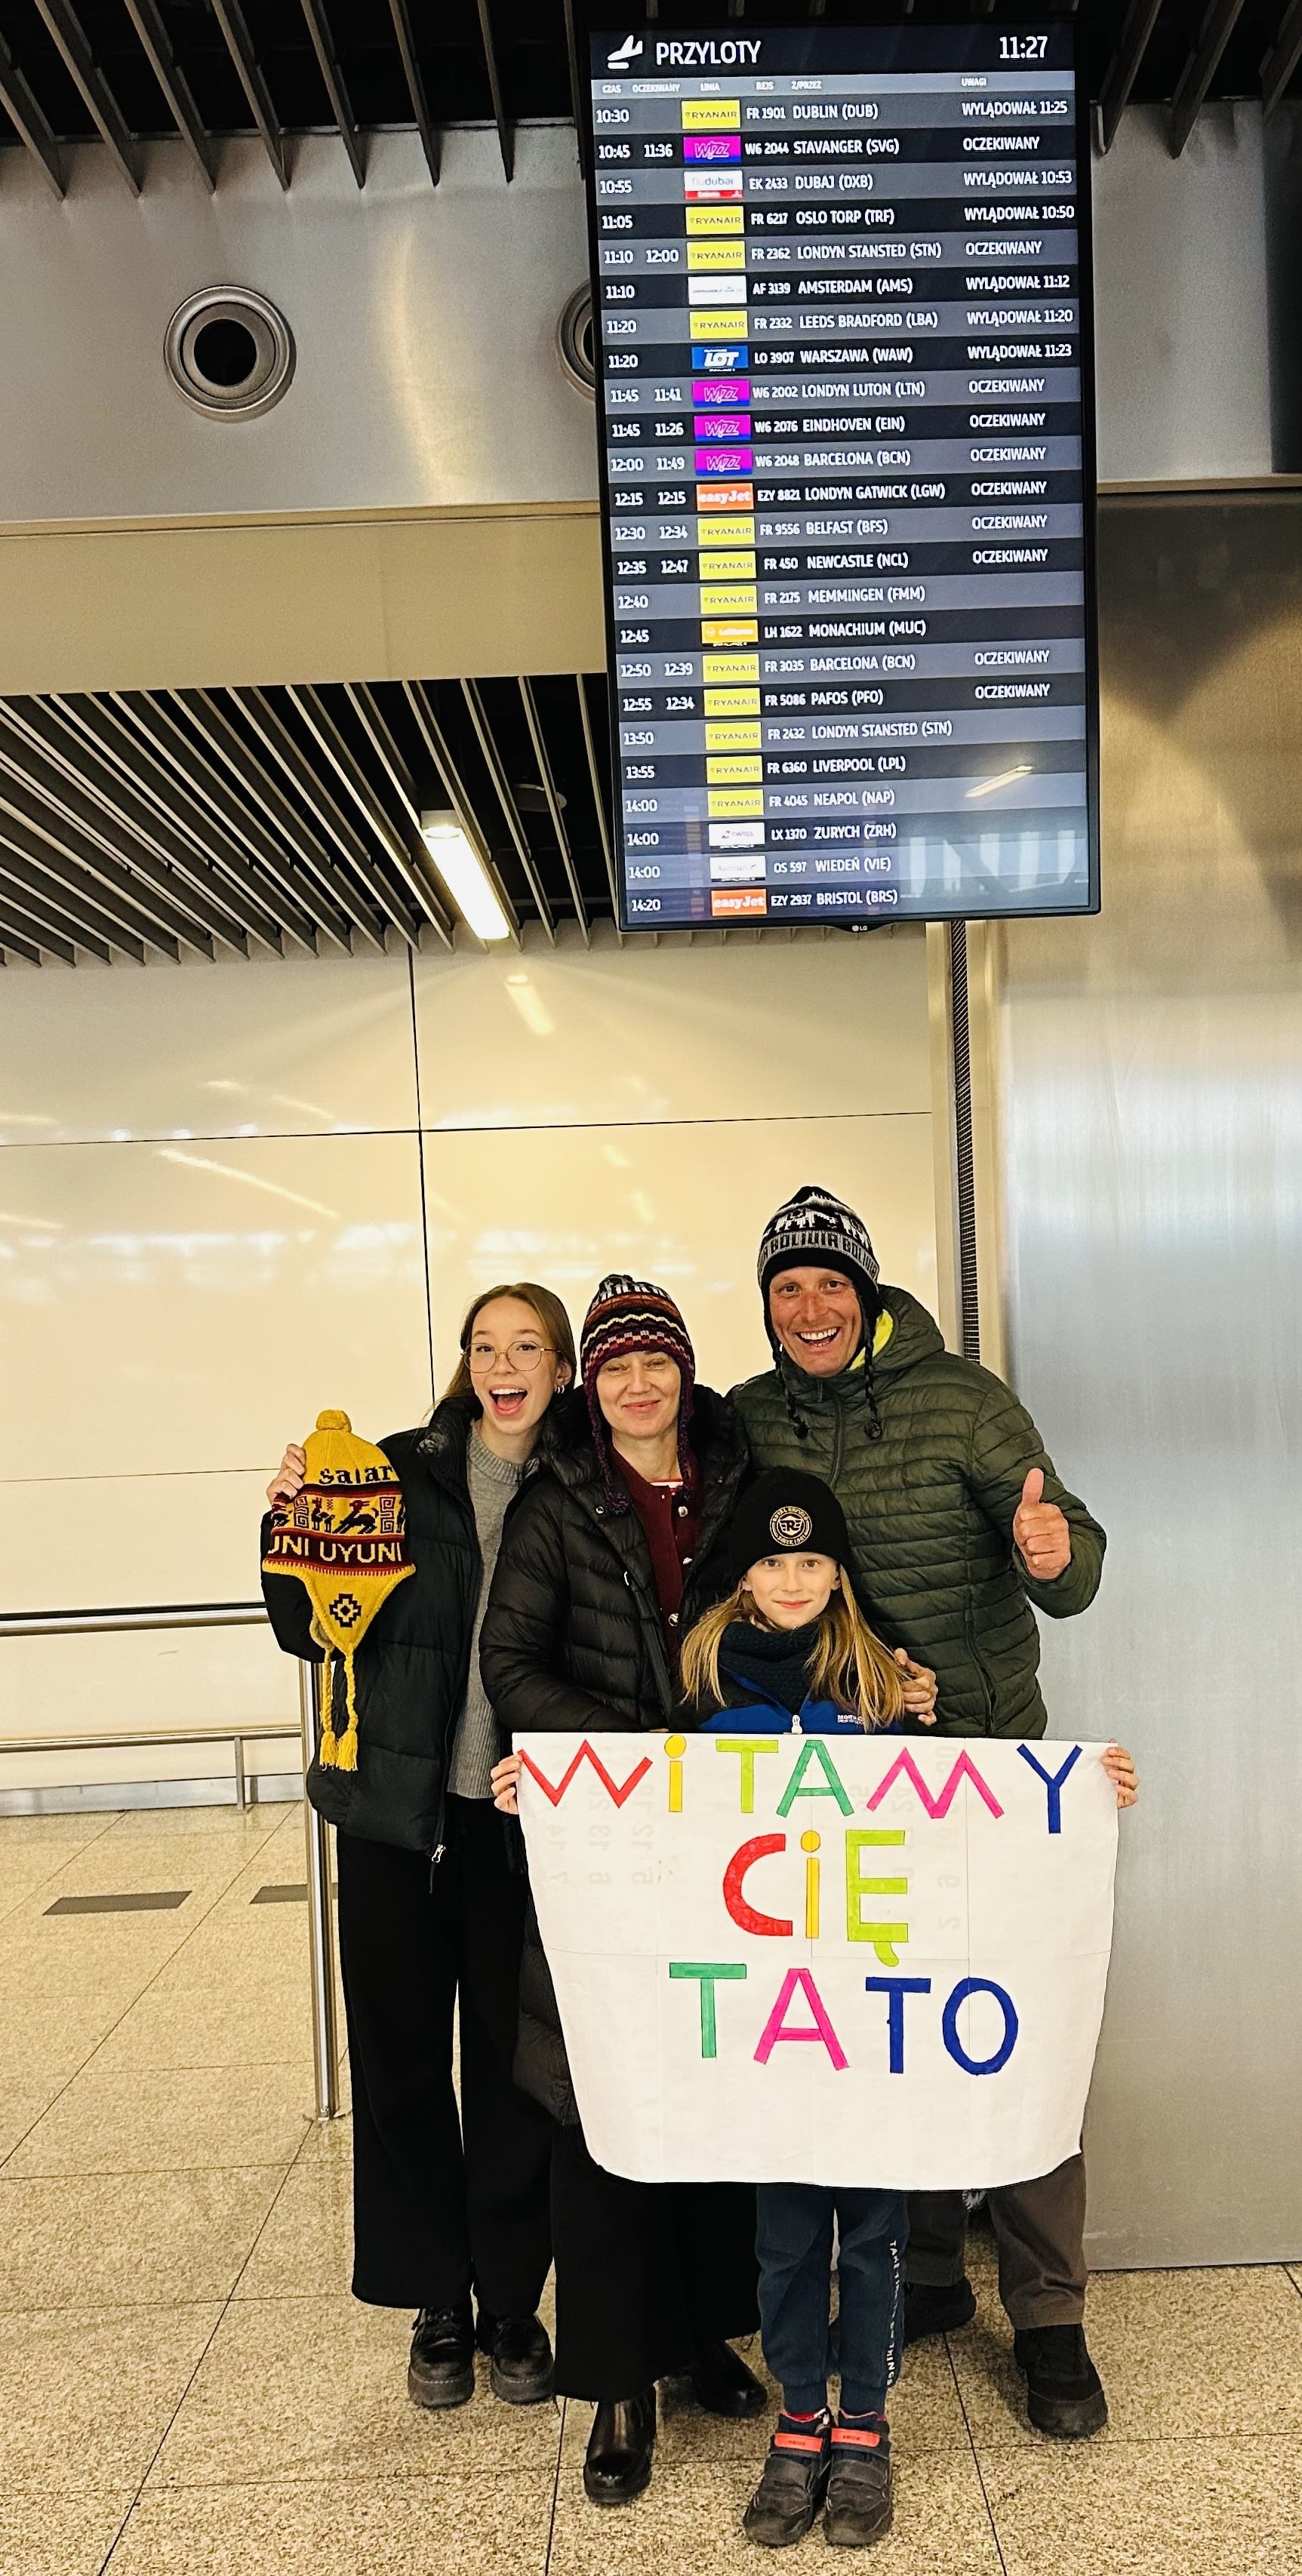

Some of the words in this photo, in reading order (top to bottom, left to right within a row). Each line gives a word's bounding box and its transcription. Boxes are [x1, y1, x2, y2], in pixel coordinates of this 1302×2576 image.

[656, 40, 762, 66] PRZYLOTY
[999, 35, 1048, 59] 11:27
[961, 77, 987, 86] UWAGI
[596, 109, 629, 123] 10:30
[746, 107, 759, 119] FR
[762, 106, 786, 118] 1901
[793, 105, 838, 118] DUBLIN
[842, 103, 878, 120] (DUB)
[961, 101, 1037, 118] WYLĄDOWAŁ
[1039, 100, 1067, 114] 11:25
[599, 144, 630, 158] 10:45
[644, 143, 673, 157] 11:36
[793, 140, 863, 154] STAVANGER
[866, 137, 899, 155] (SVG)
[962, 136, 1039, 150] OCZEKIWANY
[599, 180, 632, 193] 10:55
[795, 175, 834, 189] DUBAJ
[838, 174, 873, 190] (DXB)
[963, 171, 1039, 188] WYLĄDOWAŁ
[1041, 171, 1072, 183] 10:53
[602, 214, 633, 229] 11:05
[796, 211, 827, 224] OSLO
[830, 210, 861, 223] TORP
[864, 208, 894, 225] (TRF)
[964, 206, 1039, 223] WYLĄDOWAŁ
[1042, 205, 1074, 219] 10:50
[604, 250, 633, 263] 11:10
[645, 249, 679, 263] 12:00
[796, 245, 845, 259] LONDYN
[848, 244, 906, 258] STANSTED
[910, 242, 941, 259] (STN)
[965, 241, 1042, 255] OCZEKIWANY
[605, 284, 635, 299] 11:10
[798, 279, 873, 294] AMSTERDAM
[876, 277, 913, 294] (AMS)
[965, 275, 1041, 293] WYLĄDOWAŁ
[1043, 275, 1070, 287] 11:12
[606, 319, 636, 334] 11:20
[754, 318, 767, 329] FR
[769, 317, 793, 329] 2332
[799, 315, 835, 328] LEEDS
[838, 313, 902, 327] BRADFORD
[906, 311, 937, 328] (LBA)
[966, 310, 1042, 327] WYLĄDOWAŁ
[1044, 309, 1073, 322] 11:20
[608, 354, 638, 368] 11:20
[703, 352, 740, 367] LOT
[799, 348, 869, 363] WARSZAWA
[872, 346, 913, 364] (WAW)
[967, 344, 1042, 361] WYLĄDOWAŁ
[1044, 343, 1072, 357] 11:23
[610, 389, 639, 402] 11:45
[654, 388, 682, 401] 11:41
[802, 383, 849, 398] LONDYN
[853, 383, 891, 396] LUTON
[894, 380, 925, 398] (LTN)
[968, 378, 1045, 393] OCZEKIWANY
[611, 423, 640, 437] 11:45
[654, 422, 684, 436] 11:26
[802, 417, 871, 432] EINDHOVEN
[875, 415, 905, 432] (EIN)
[969, 413, 1045, 427] OCZEKIWANY
[611, 458, 643, 472] 12:00
[656, 456, 685, 470] 11:49
[804, 451, 873, 466] BARCELONA
[876, 449, 910, 466] (BCN)
[970, 447, 1046, 461] OCZEKIWANY
[614, 492, 643, 506] 12:15
[657, 490, 686, 505] 12:15
[697, 489, 752, 505] easyJet
[805, 486, 852, 500] LONDYN
[855, 484, 908, 499] GATWICK
[910, 482, 945, 500] (LGW)
[971, 481, 1047, 496] OCZEKIWANY
[615, 526, 645, 540] 12:30
[659, 525, 688, 539] 12:34
[759, 524, 773, 535] FR
[774, 523, 800, 535] 9556
[805, 520, 854, 534] BELFAST
[857, 518, 888, 535] (BFS)
[971, 515, 1047, 529] OCZEKIWANY
[617, 561, 646, 574] 12:35
[660, 559, 688, 573] 12:47
[807, 554, 873, 569] NEWCASTLE
[876, 552, 908, 569] (NCL)
[972, 549, 1048, 564] OCZEKIWANY
[617, 595, 648, 609] 12:40
[808, 588, 883, 603] MEMMINGEN
[887, 586, 925, 603] (FMM)
[620, 629, 649, 643] 12:45
[808, 622, 885, 637] MONACHIUM
[888, 619, 926, 637] (MUC)
[620, 663, 651, 677] 12:50
[664, 662, 693, 676] 12:39
[810, 656, 879, 671] BARCELONA
[882, 653, 916, 671] (BCN)
[974, 650, 1049, 665] OCZEKIWANY
[623, 697, 651, 711] 12:55
[666, 696, 695, 710] 12:34
[811, 690, 848, 705] PAFOS
[851, 689, 883, 706] (PFO)
[974, 683, 1050, 699] OCZEKIWANY
[623, 731, 654, 745] 13:50
[811, 724, 858, 739] LONDYN
[861, 722, 917, 736] STANSTED
[922, 720, 952, 737] (STN)
[626, 765, 654, 779] 13:55
[813, 758, 875, 773] LIVERPOOL
[878, 755, 906, 773] (LPL)
[625, 799, 657, 812] 14:00
[814, 792, 858, 805] NEAPOL
[861, 789, 894, 806] (NAP)
[626, 832, 659, 846] 14:00
[814, 825, 860, 839] ZURYCH
[863, 822, 896, 840] (ZRH)
[629, 865, 660, 878] 14:00
[814, 856, 860, 871] WIEDEŃ
[863, 856, 892, 872] (VIE)
[631, 899, 660, 911] 14:20
[714, 896, 765, 909] easyJet
[816, 891, 863, 905] BRISTOL
[866, 889, 898, 905] (BRS)
[319, 1541, 402, 1563] UYUNI
[669, 1962, 1020, 2076] TATO
